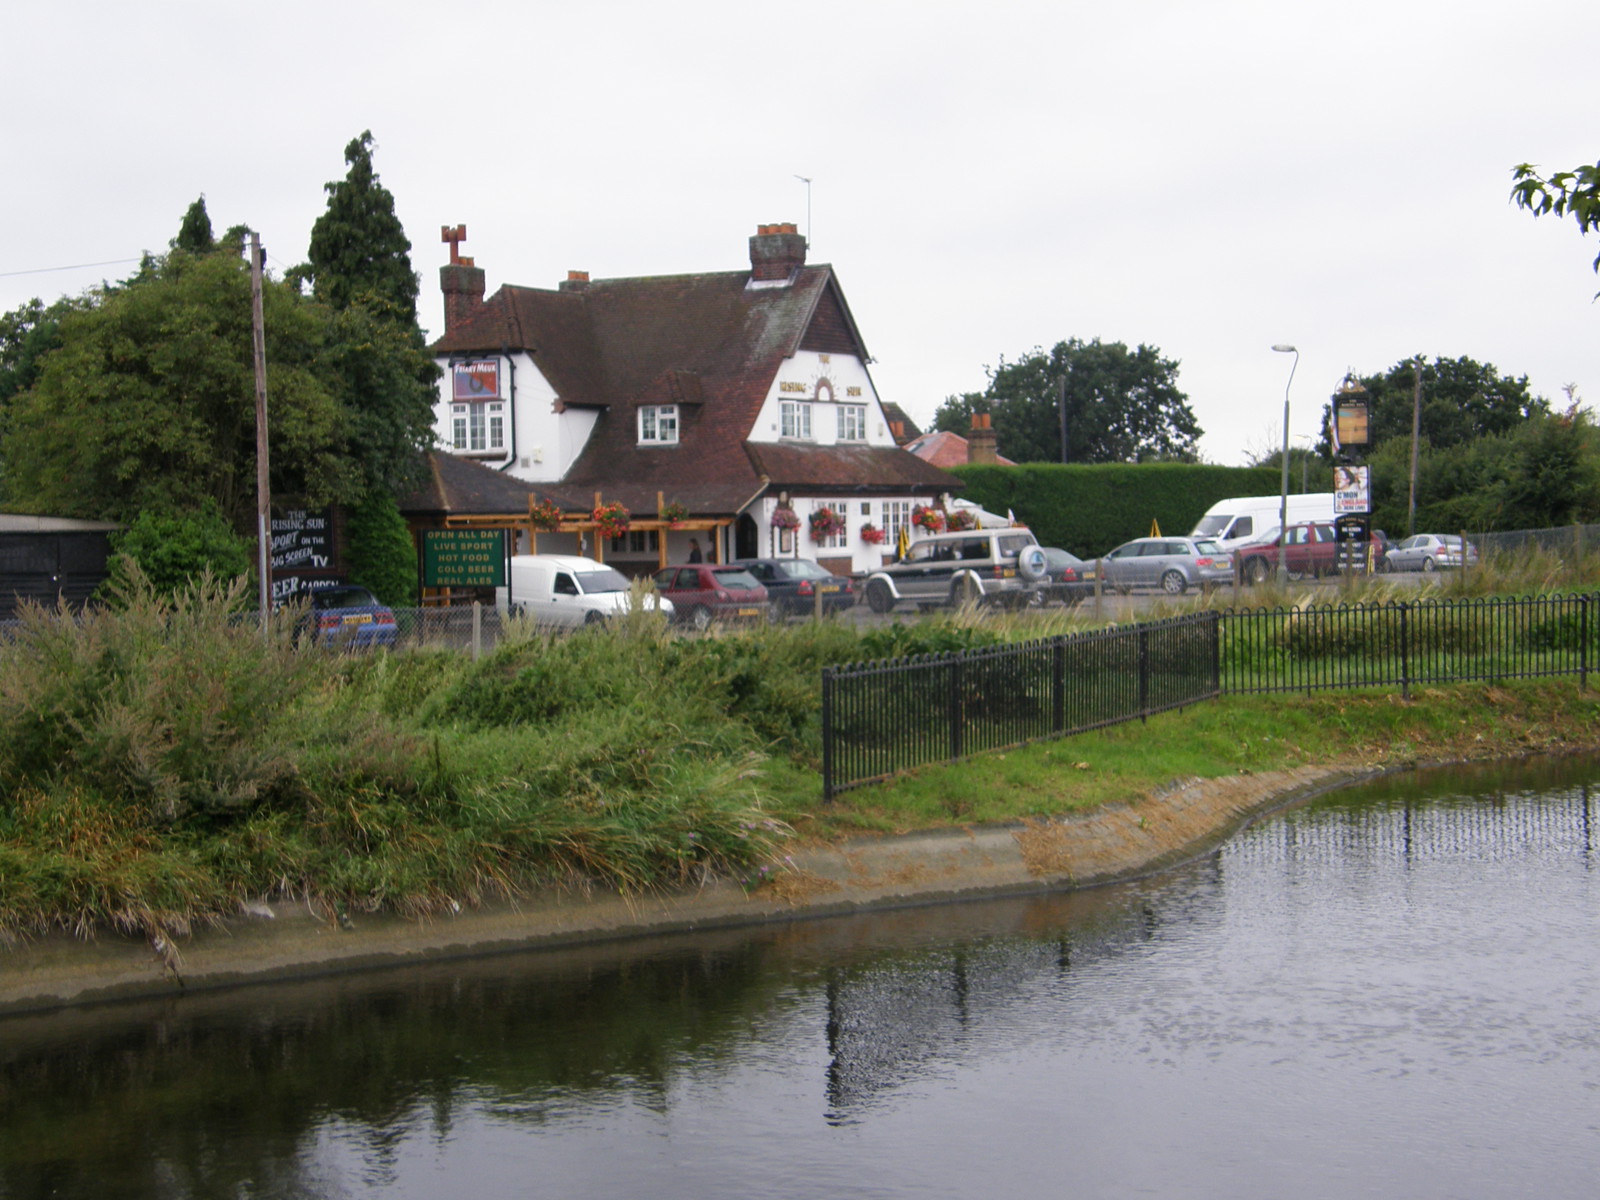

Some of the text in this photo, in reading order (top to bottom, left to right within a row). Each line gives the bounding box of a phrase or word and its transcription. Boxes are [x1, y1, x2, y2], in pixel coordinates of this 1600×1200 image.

[288, 511, 306, 519] THE
[272, 518, 325, 530] RISING SUN
[427, 530, 499, 539] OPEN ALL DAY
[301, 537, 311, 545] ON
[312, 536, 325, 544] THE
[461, 542, 493, 550] SPORT
[285, 547, 313, 563] SCREEN
[311, 555, 328, 568] TV
[438, 554, 490, 562] HOT FOOD
[437, 565, 494, 573] COLD BEER
[437, 577, 492, 585] REAL ALES
[272, 576, 299, 598] EER
